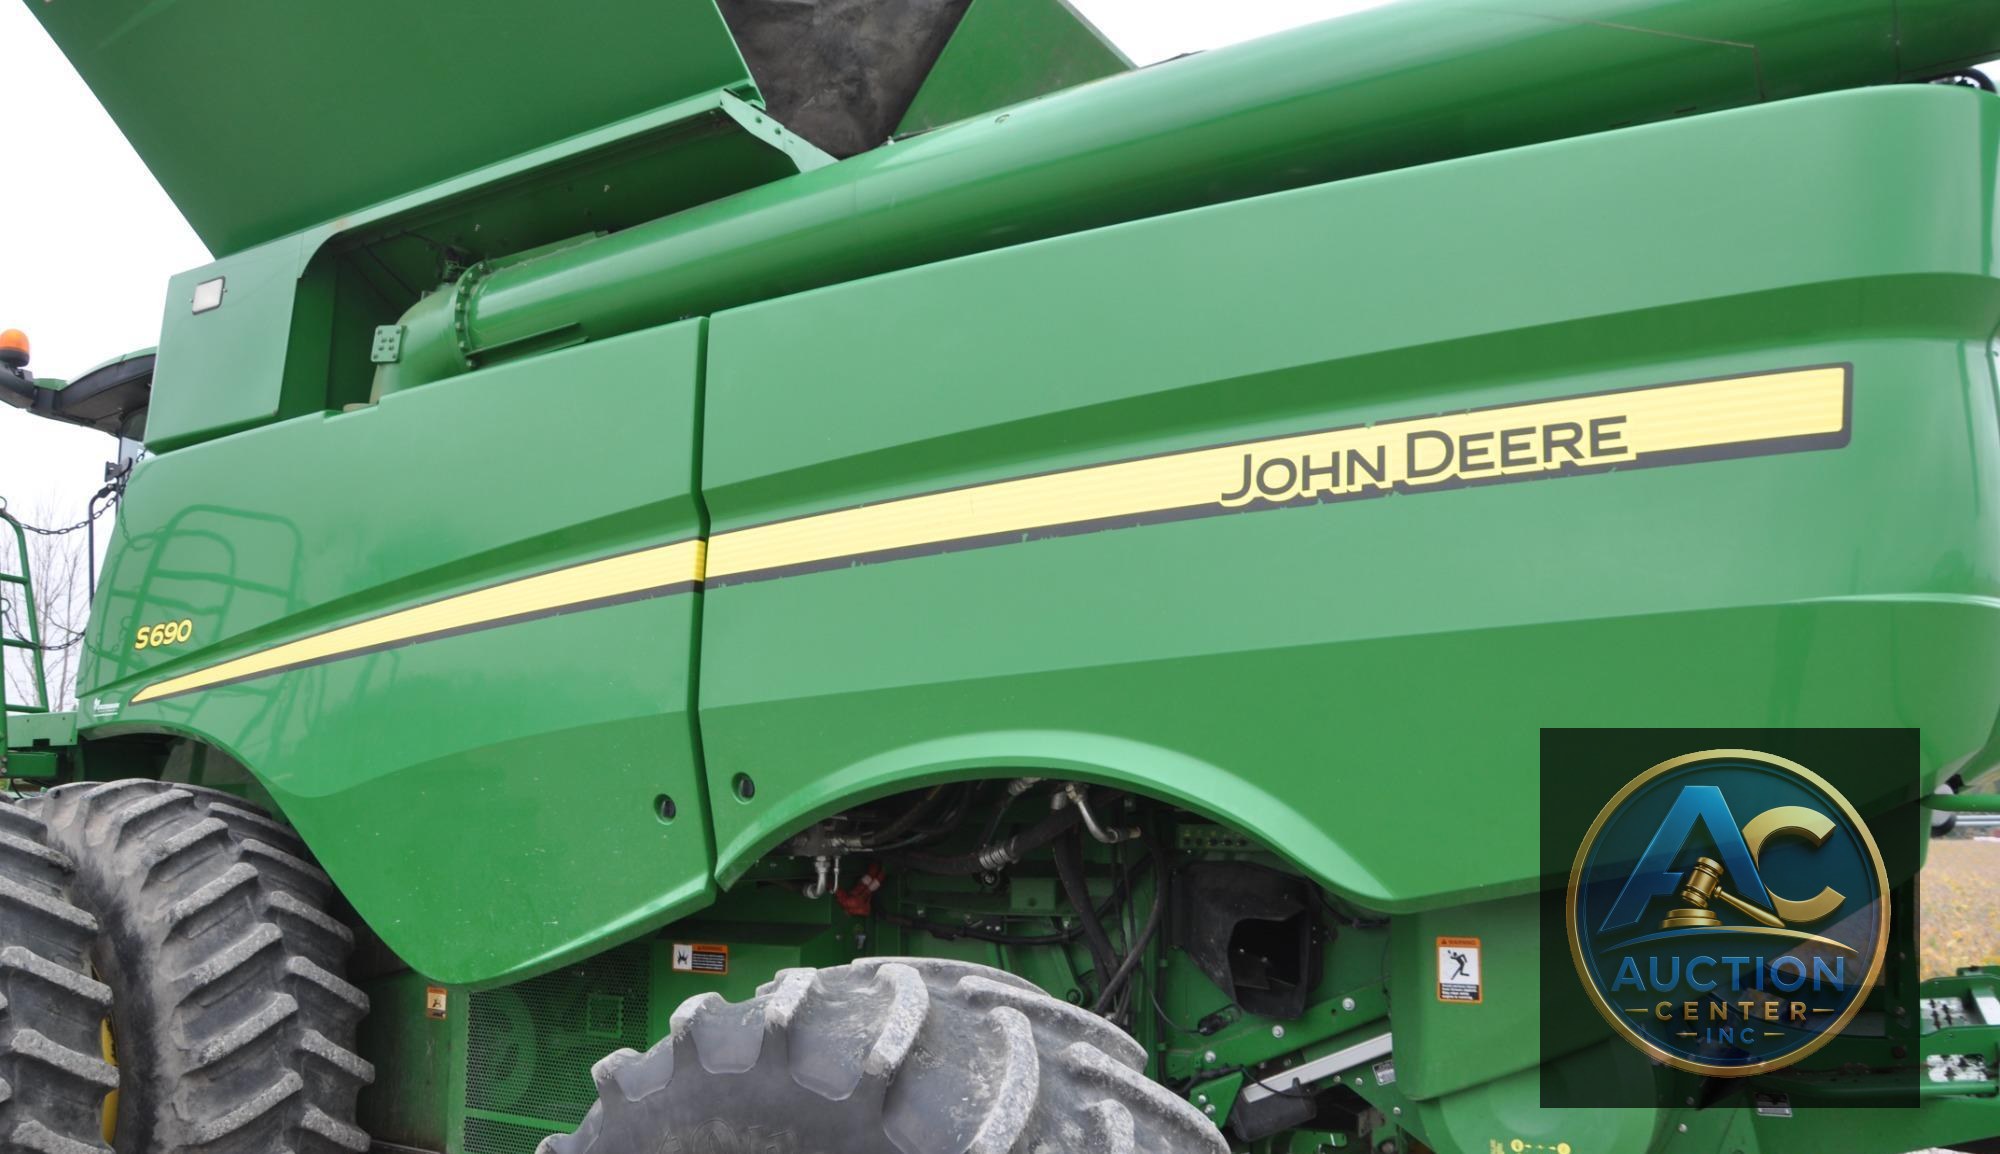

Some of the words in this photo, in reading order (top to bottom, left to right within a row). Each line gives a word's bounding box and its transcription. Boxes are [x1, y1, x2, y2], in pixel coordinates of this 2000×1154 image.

[1221, 444, 1387, 502] JOHN
[1407, 414, 1629, 479] DEERE
[134, 618, 193, 651] S690
